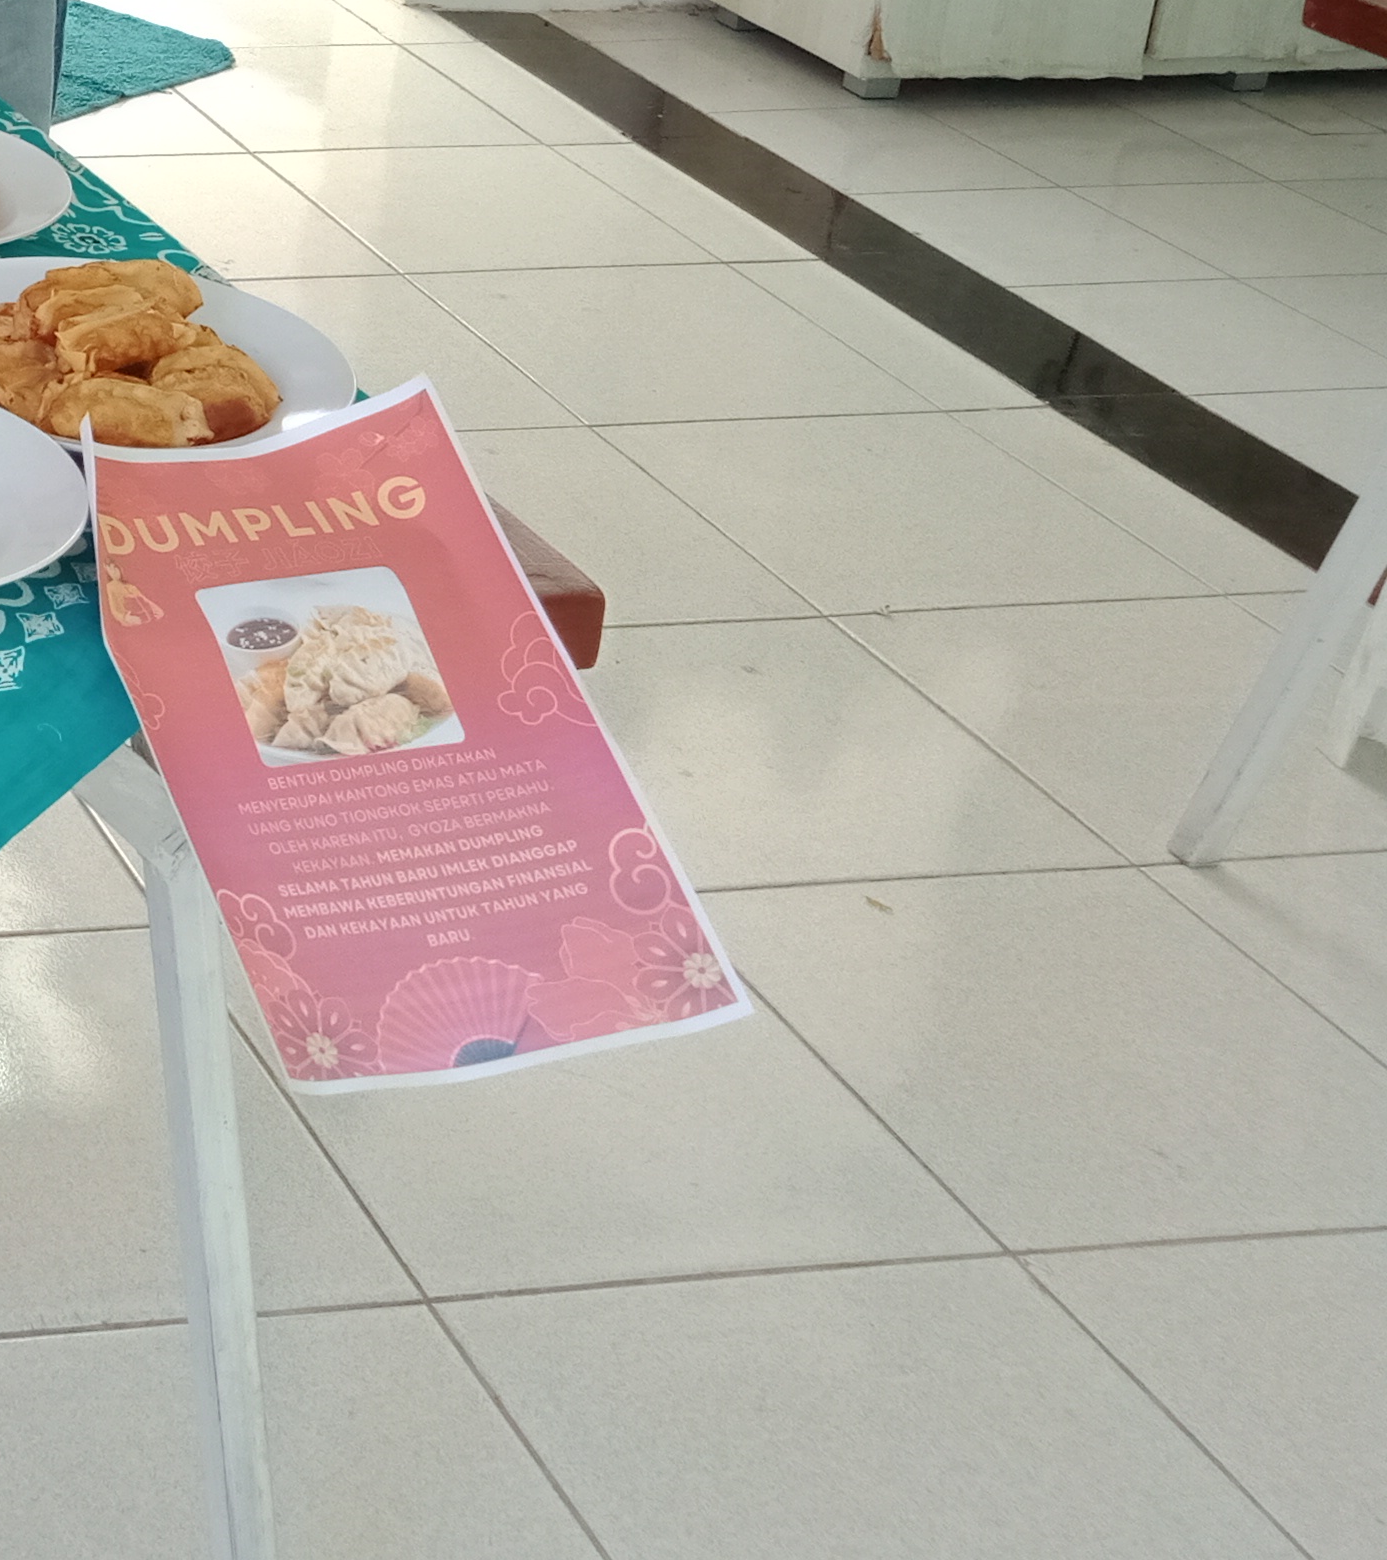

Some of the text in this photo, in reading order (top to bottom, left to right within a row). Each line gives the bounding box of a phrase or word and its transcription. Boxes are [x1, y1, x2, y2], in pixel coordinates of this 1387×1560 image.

[98, 476, 426, 554] DUMPLING
[238, 758, 547, 815] MENYERUPAI KANTONG EMAS ATAU MATA
[267, 748, 497, 790] BENTUK DUMPLING DIKATAKAN
[247, 779, 555, 836] UANG KUNO TIONGKOK SEPERTI PERAHU.
[269, 801, 552, 855] OLEH KARENA ITU, GYOZA BERMAKNA
[278, 839, 578, 897] SELAMA TAHUN BARU IMLEK DIANGGAP
[377, 841, 456, 864] MEMAKAN
[458, 824, 544, 851] DUMPLING
[283, 859, 593, 919] MEMBAWA KEBERUNTUNGAN FINANSIAL
[303, 882, 589, 940] DAN KEKAYAAN UNTUK TAHUN YANG
